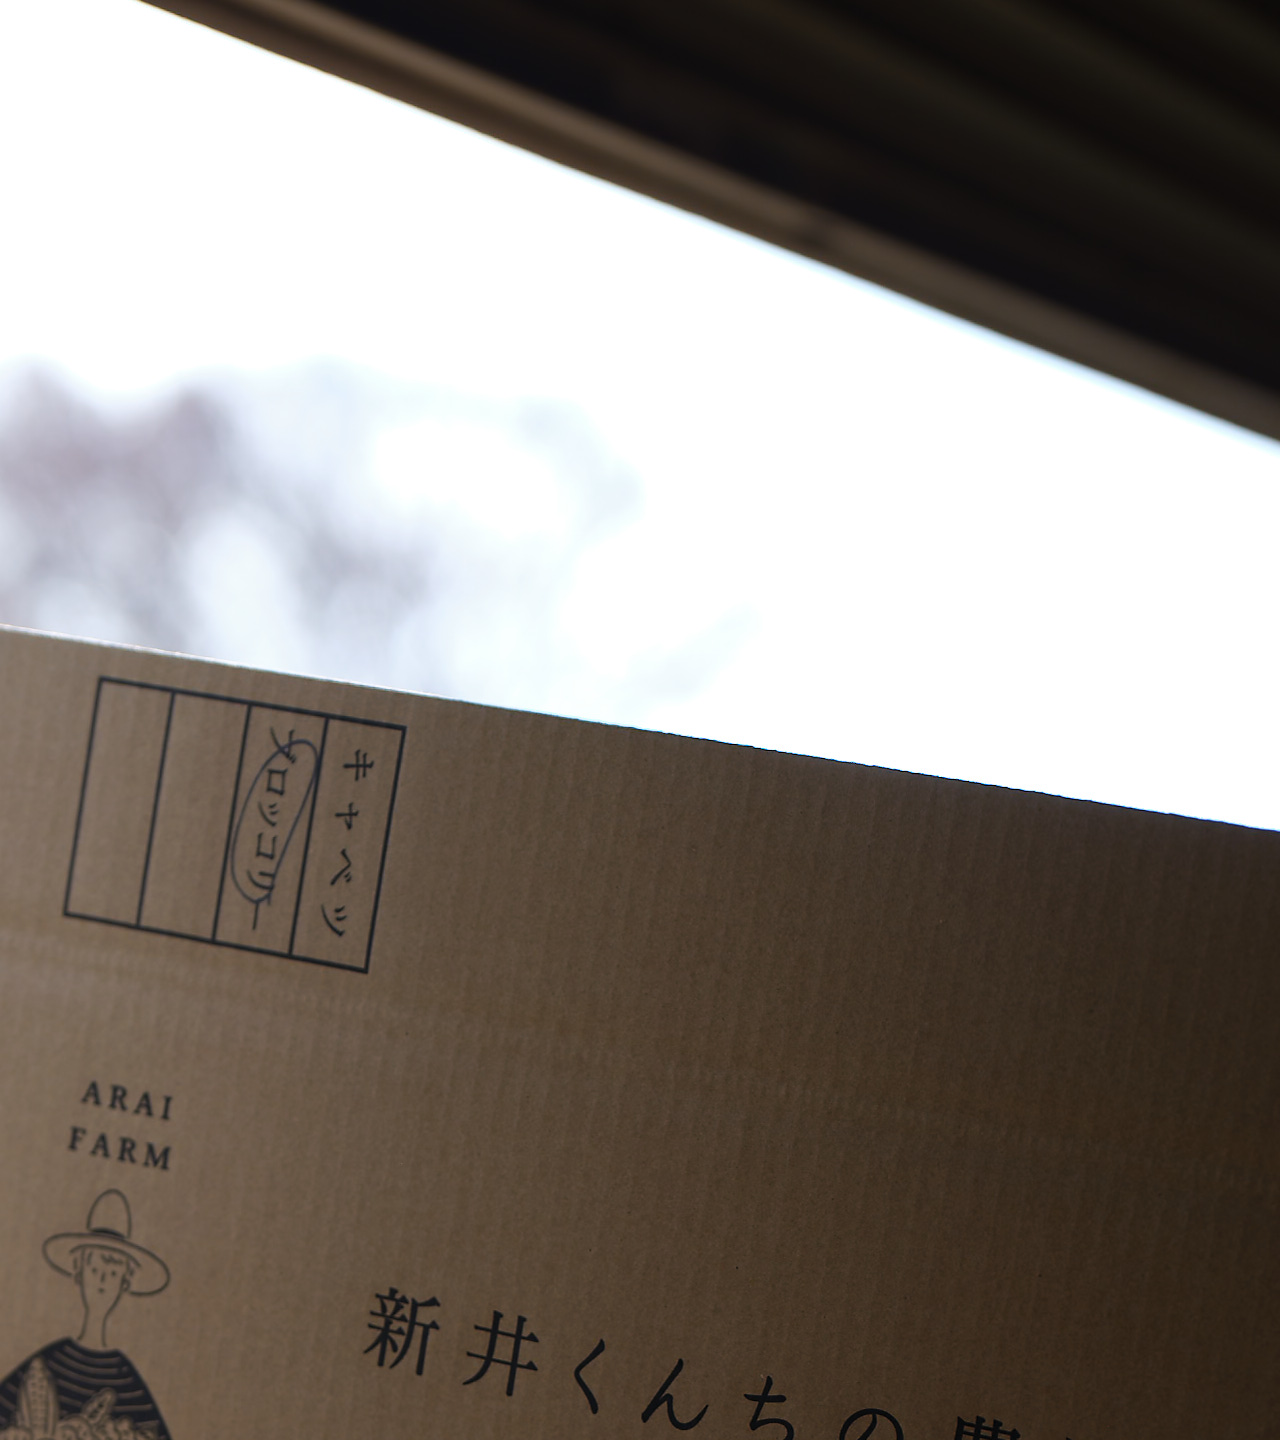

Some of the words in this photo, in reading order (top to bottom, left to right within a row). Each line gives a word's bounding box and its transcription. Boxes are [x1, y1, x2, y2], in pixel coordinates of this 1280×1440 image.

[246, 727, 296, 930] ブロッコリー
[322, 749, 374, 937] キャベツ
[67, 1127, 171, 1171] FARM
[81, 1080, 171, 1121] ARAI
